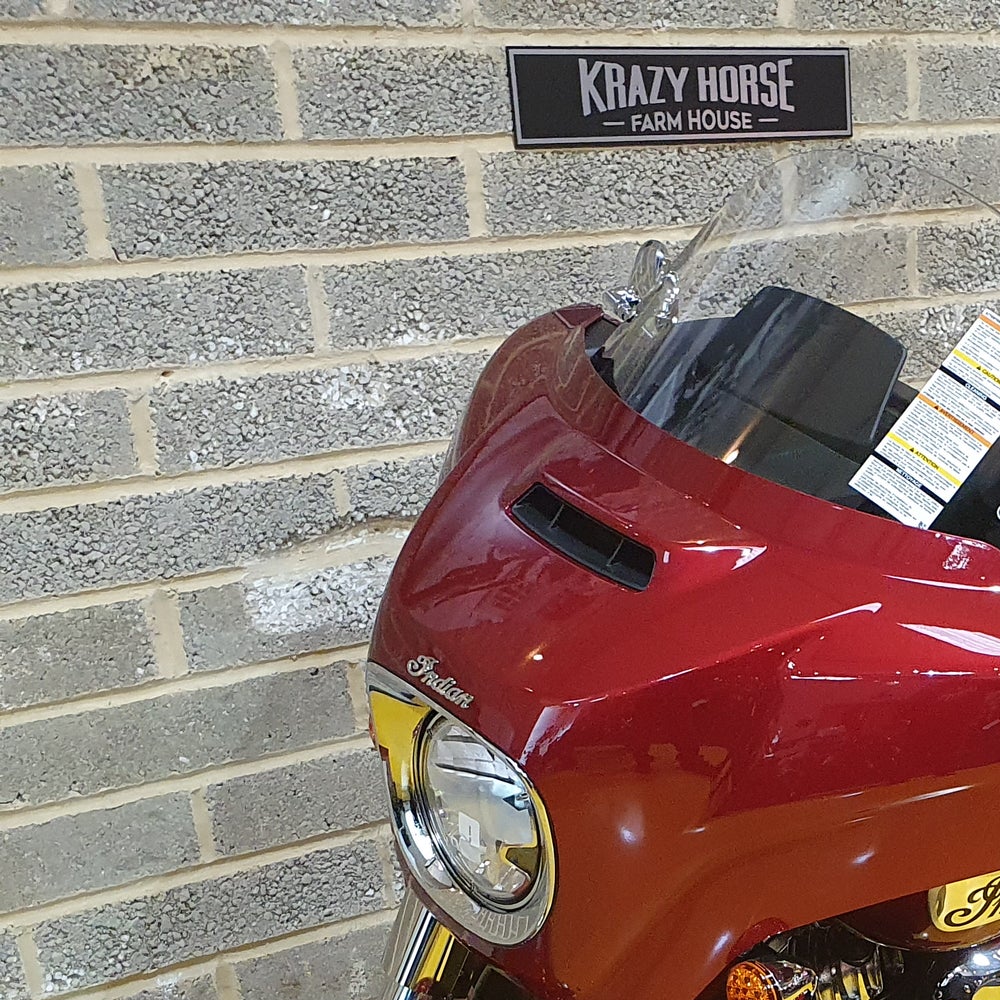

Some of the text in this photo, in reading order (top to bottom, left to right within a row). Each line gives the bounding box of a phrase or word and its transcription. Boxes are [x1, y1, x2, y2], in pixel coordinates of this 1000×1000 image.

[578, 58, 795, 117] KRAZY HORSE
[631, 108, 753, 132] FARM HOUSE
[964, 383, 988, 401] CLEANING
[914, 450, 940, 470] ATTENTION
[406, 655, 474, 709] Indian
